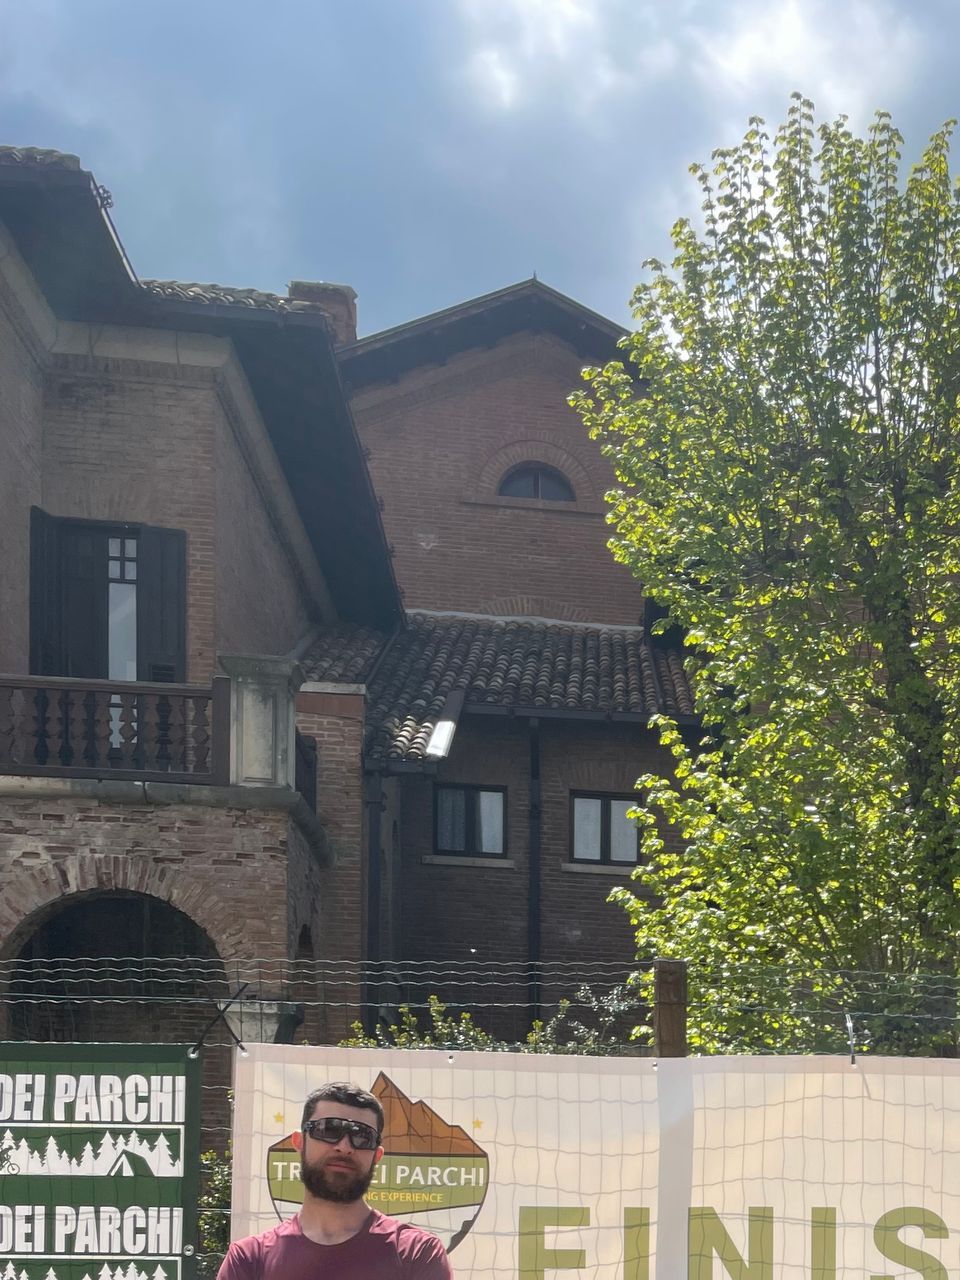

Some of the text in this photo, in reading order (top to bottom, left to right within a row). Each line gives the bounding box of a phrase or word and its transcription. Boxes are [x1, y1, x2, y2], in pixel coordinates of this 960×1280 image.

[54, 1074, 186, 1122] PARCHI
[396, 1165, 485, 1187] PARCHI
[380, 1191, 444, 1203] EXPERIENCE
[55, 1206, 183, 1254] PARCHI
